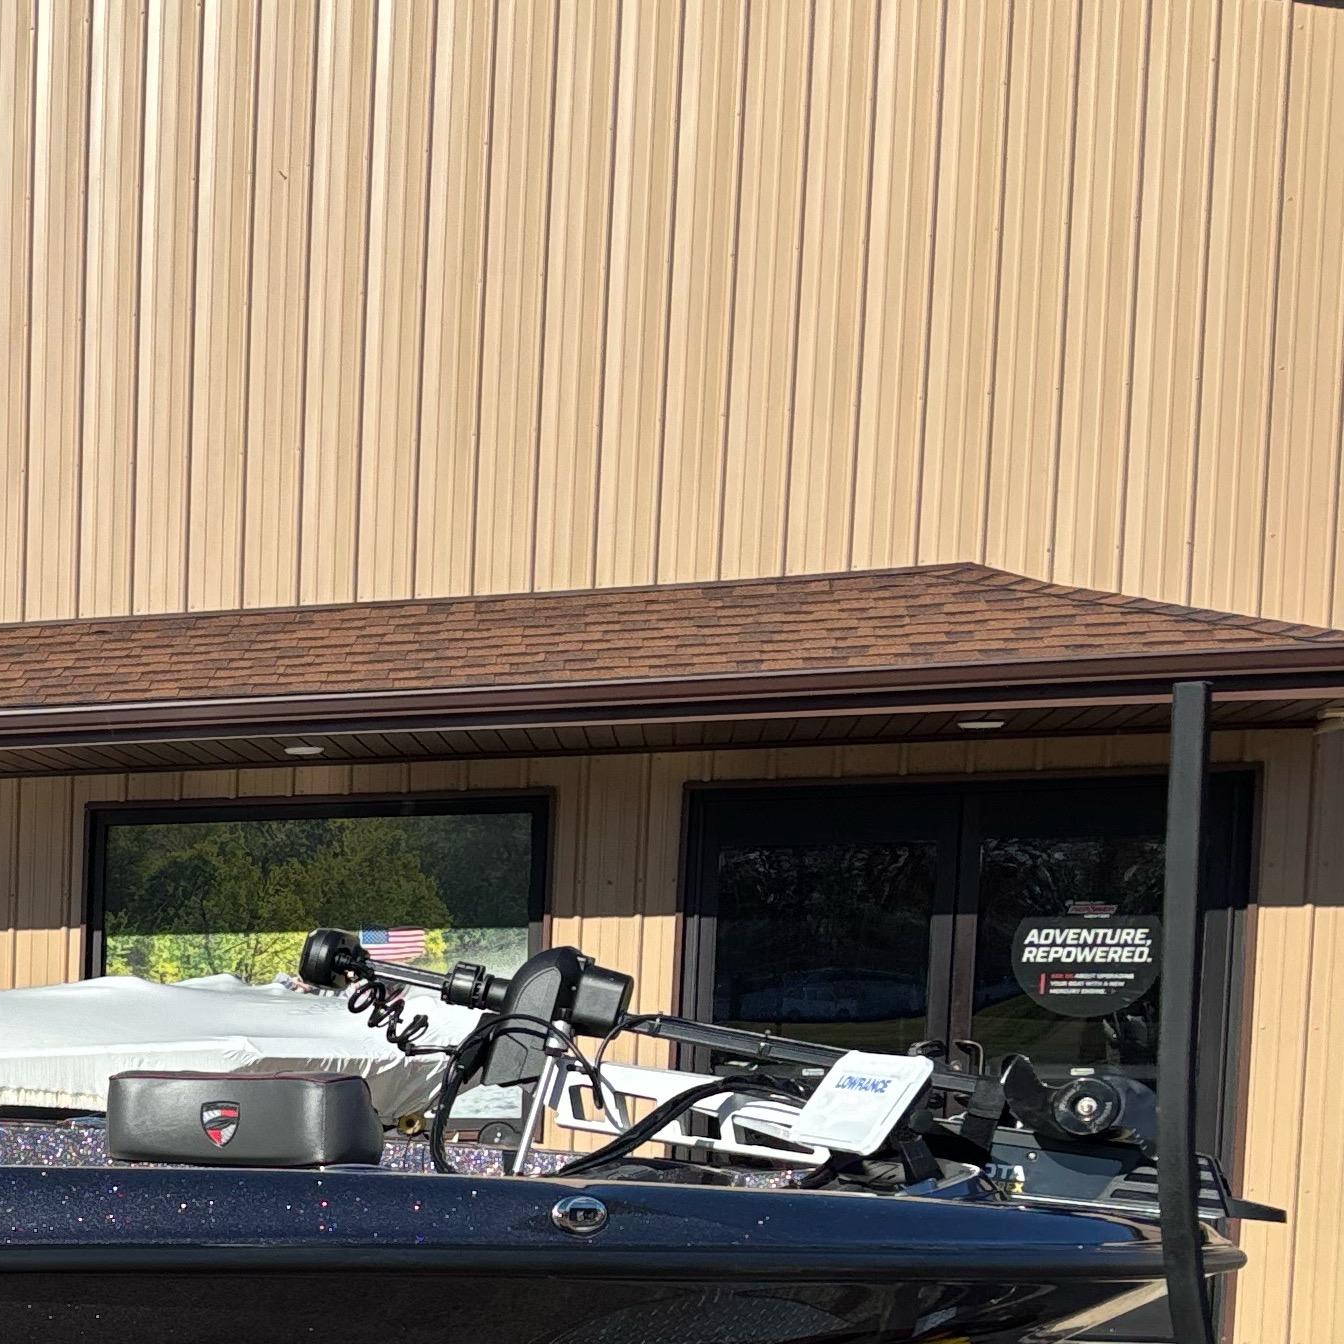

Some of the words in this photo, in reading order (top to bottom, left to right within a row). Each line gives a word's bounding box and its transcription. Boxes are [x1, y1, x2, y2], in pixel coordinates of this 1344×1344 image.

[1024, 928, 1152, 947] ADVENTURE,
[1021, 947, 1153, 963] REPOWERED.
[835, 1075, 893, 1094] LOWRANCE
